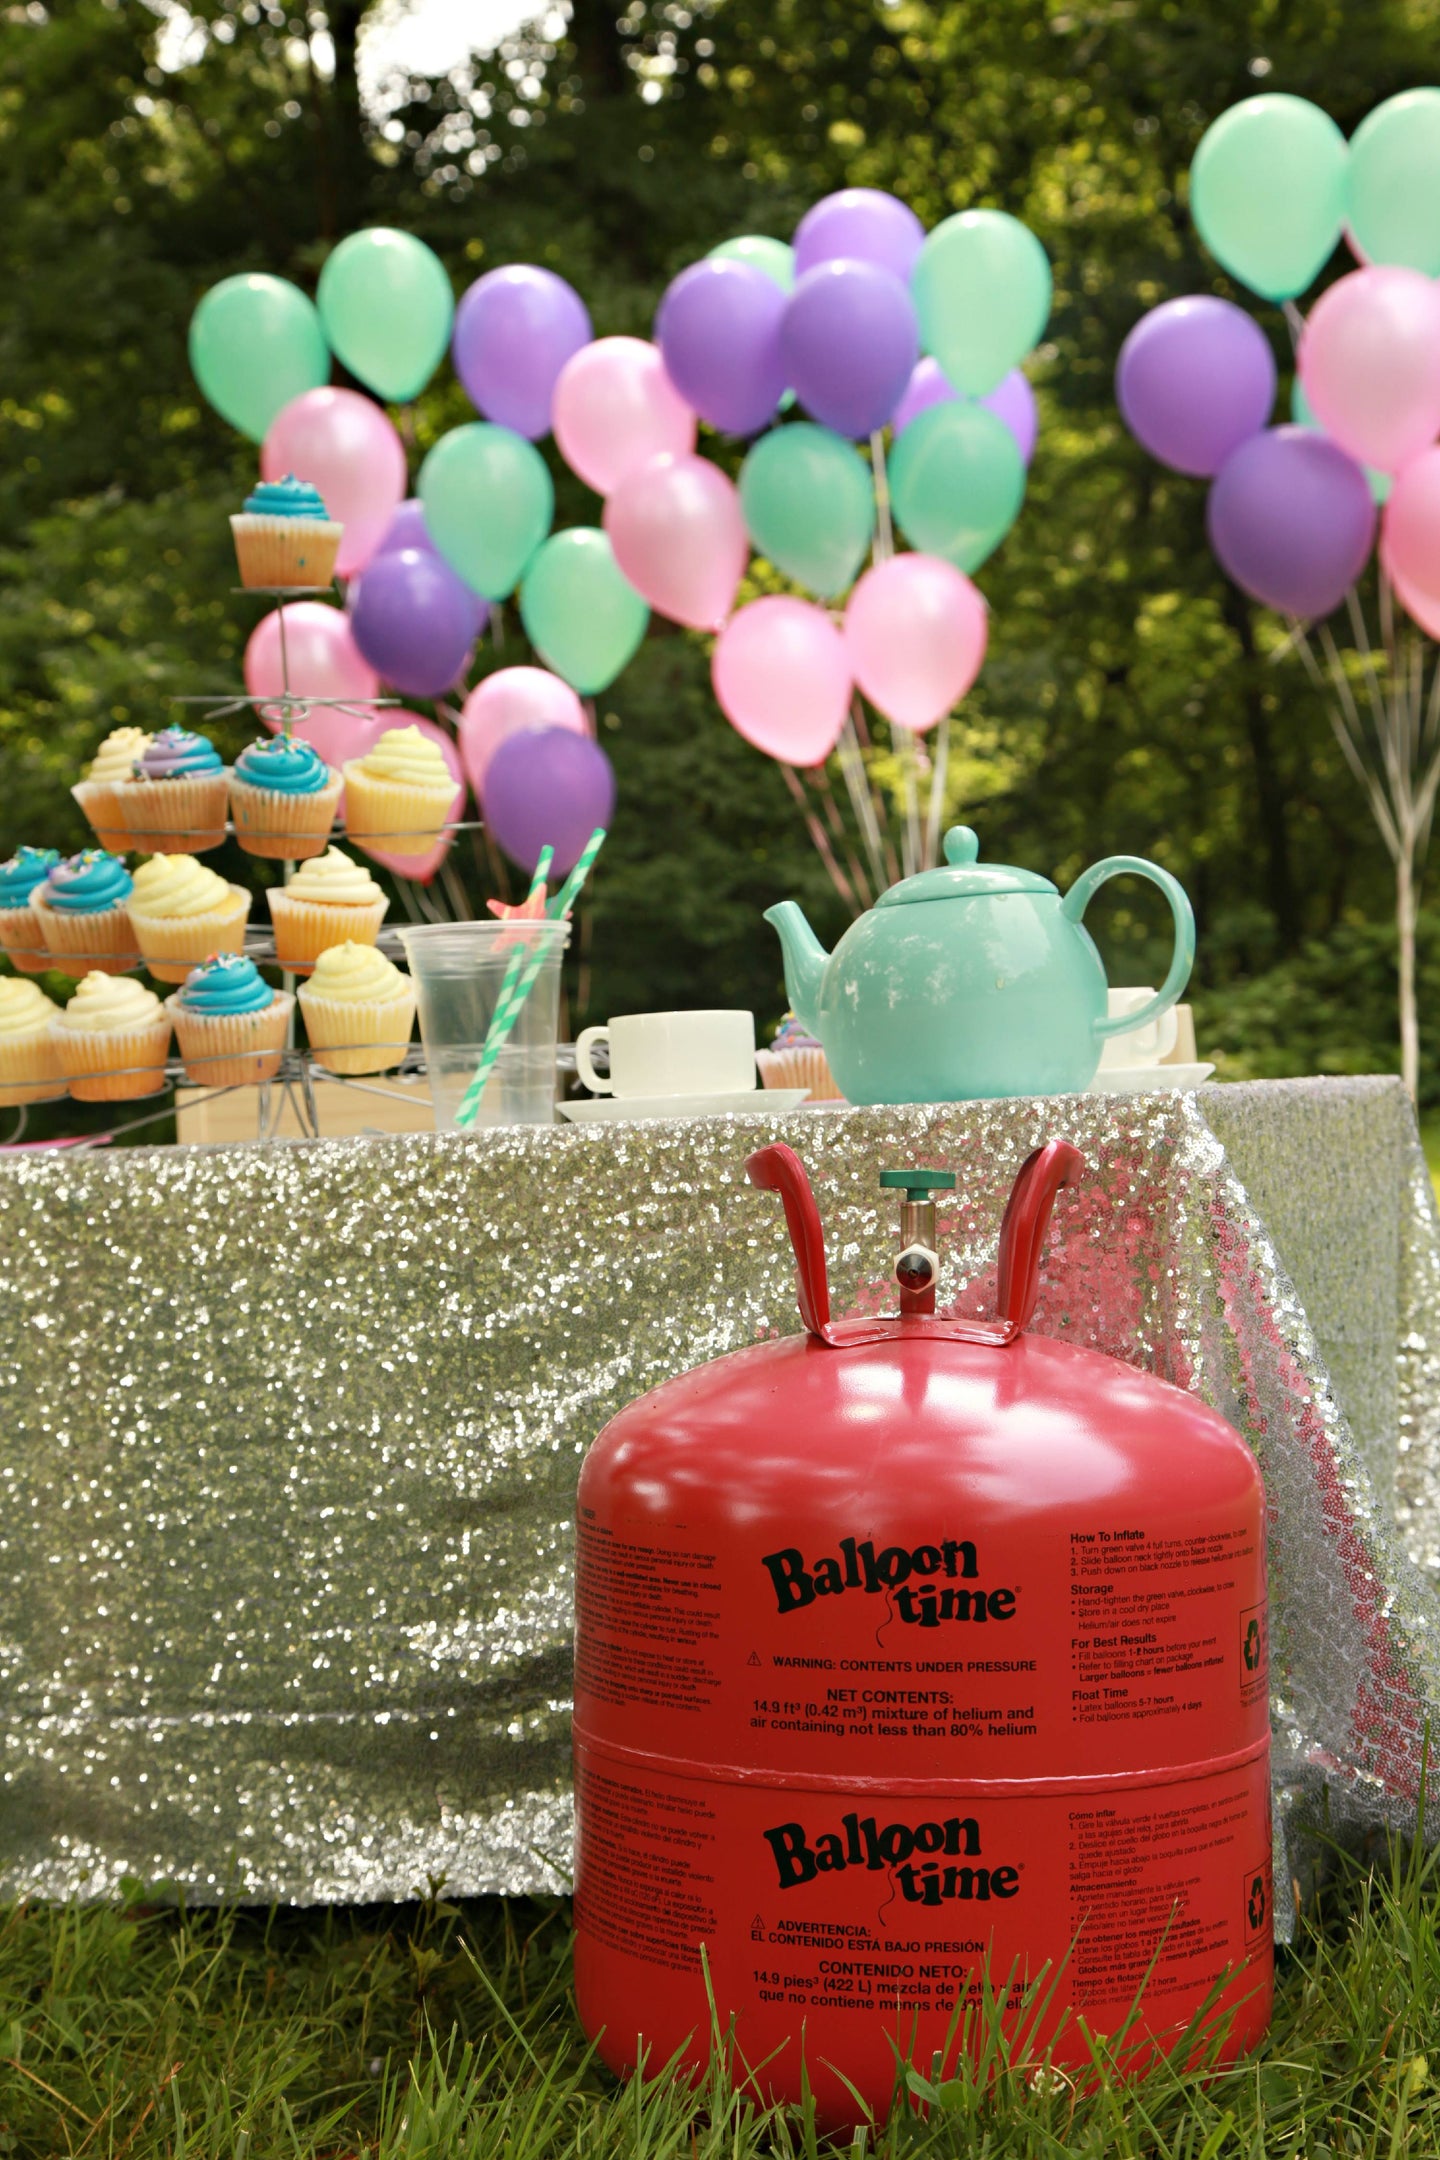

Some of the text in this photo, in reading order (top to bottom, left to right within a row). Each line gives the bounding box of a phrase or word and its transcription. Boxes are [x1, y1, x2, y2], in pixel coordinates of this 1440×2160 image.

[1070, 1530, 1145, 1543] How To Inflate
[1080, 1556, 1101, 1566] Slide
[1103, 1554, 1132, 1564] balloon
[1134, 1553, 1151, 1562] neck
[1153, 1550, 1174, 1561] tightly
[1175, 1548, 1190, 1557] onto
[1081, 1546, 1099, 1555] Turn
[1101, 1546, 1123, 1555] green
[1125, 1543, 1145, 1552] valve
[762, 1537, 979, 1614] Balloon
[1080, 1566, 1102, 1576] Push
[1104, 1565, 1126, 1575] down
[1127, 1565, 1138, 1573] on
[1139, 1562, 1158, 1571] black
[1160, 1559, 1182, 1569] nozzle
[1182, 1558, 1190, 1567] to
[1070, 1584, 1114, 1596] Storage
[1078, 1596, 1131, 1607] Hand-tighten
[1132, 1594, 1145, 1603] the
[1146, 1593, 1166, 1603] green
[1078, 1607, 1101, 1617] Store
[1102, 1606, 1110, 1615] in
[1119, 1604, 1136, 1614] cool
[1137, 1603, 1149, 1614] dry
[1150, 1602, 1170, 1613] place
[1121, 1617, 1141, 1628] does
[1142, 1616, 1154, 1625] not
[1155, 1614, 1177, 1625] expire
[1071, 1633, 1157, 1650] For Best Results
[1078, 1651, 1091, 1661] Fill
[1092, 1650, 1127, 1660] balloons
[1143, 1645, 1165, 1655] hours
[1166, 1642, 1187, 1652] before
[1188, 1641, 1201, 1651] your
[772, 1656, 1037, 1672] WARNING: CONTENTS UNDER PRESSURE
[1078, 1652, 1194, 1671] Refer to filling chart on package
[1079, 1672, 1109, 1683] Larger
[1110, 1669, 1146, 1680] balloons
[1153, 1665, 1174, 1675] fewer
[1175, 1661, 1203, 1672] balloons
[826, 1688, 954, 1704] NET CONTENTS:
[1072, 1688, 1129, 1701] Float Time
[753, 1700, 781, 1713] 14.9
[804, 1703, 838, 1718] (0.42
[871, 1707, 929, 1720] mixture
[933, 1708, 949, 1720] of
[952, 1707, 1002, 1720] helium
[1006, 1706, 1034, 1719] and
[1079, 1702, 1103, 1713] Latex
[1104, 1700, 1138, 1711] balloons
[1153, 1695, 1175, 1704] hours
[1079, 1713, 1095, 1722] Foil
[1096, 1711, 1131, 1722] balloons
[1132, 1704, 1181, 1720] approximately
[1188, 1700, 1203, 1711] days
[750, 1716, 1037, 1737] air containing not less than 80% helium
[763, 1813, 982, 1889] Balloon
[1070, 1879, 1137, 1892] Almacenamiento
[777, 1920, 871, 1937] ADVERTENCIA:
[751, 1930, 985, 1952] EL CONTENIDO ESTÁ BAJO PRESIÓN
[819, 1960, 967, 1978] CONTENIDO NETO:
[753, 1970, 781, 1985] 14.9
[822, 1977, 854, 1993] (422
[857, 1980, 871, 1995] L)
[876, 1982, 931, 1995] mezcla
[935, 1982, 955, 1994] de
[759, 1989, 784, 2002] que
[788, 1992, 806, 2004] no
[810, 1994, 875, 2009] contiene
[878, 1998, 931, 2011] menos
[935, 1998, 955, 2011] de
